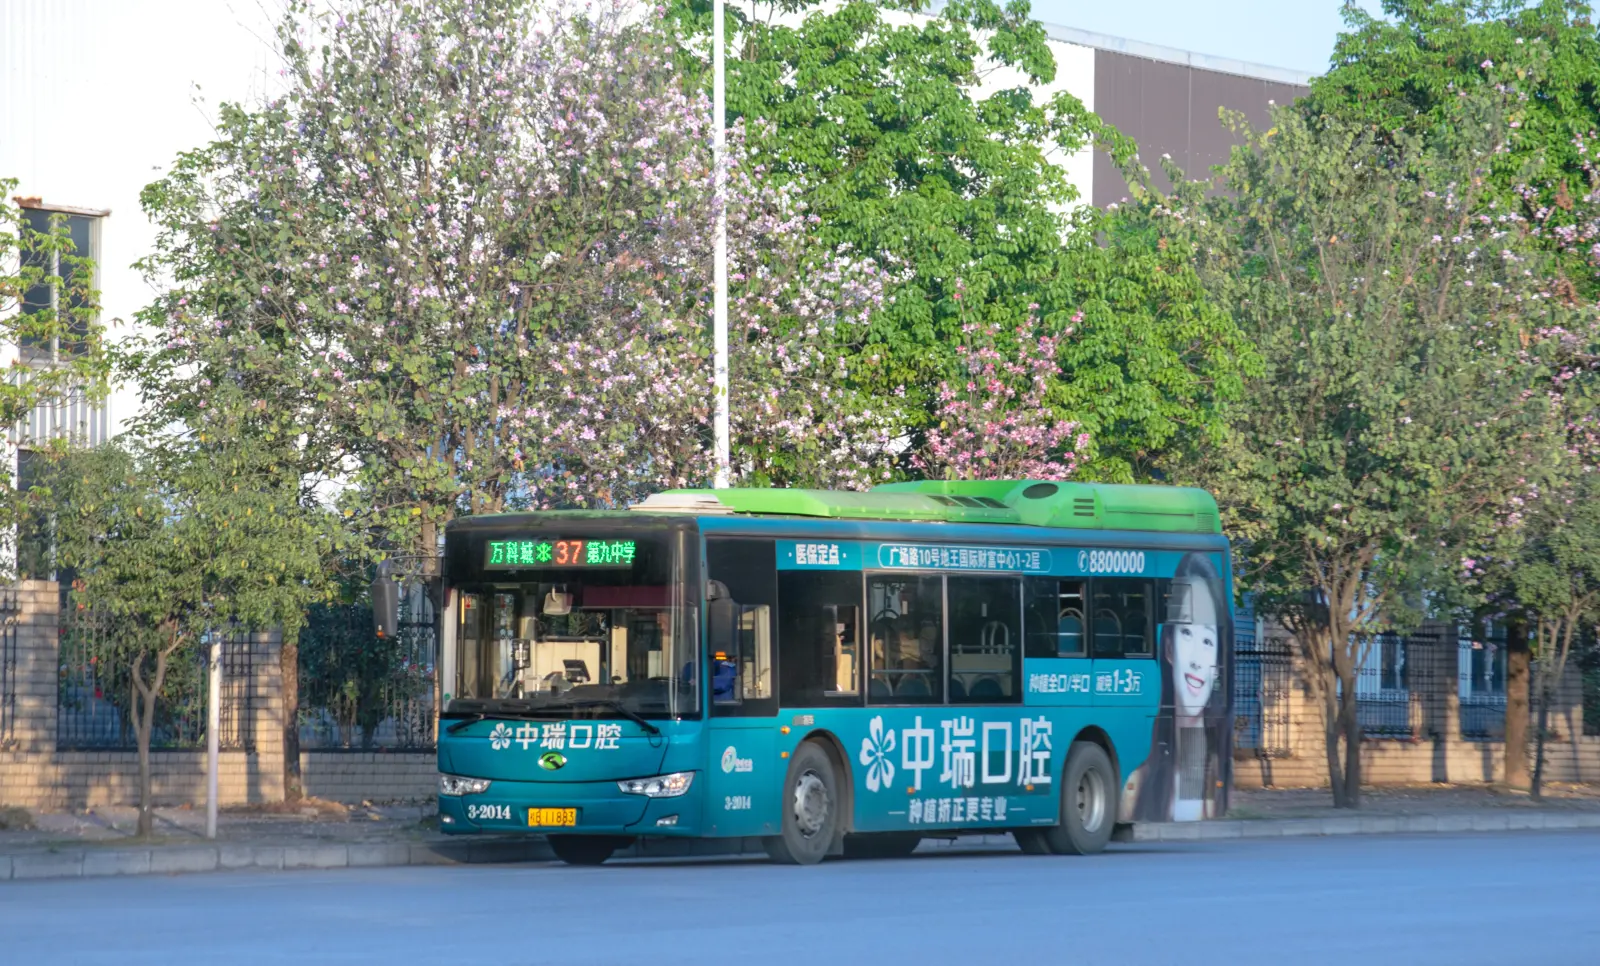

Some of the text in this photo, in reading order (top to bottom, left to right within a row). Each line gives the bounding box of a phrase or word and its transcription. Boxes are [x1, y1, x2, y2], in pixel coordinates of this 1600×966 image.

[556, 540, 582, 564] 37
[586, 541, 636, 564] 第九中学
[795, 544, 840, 565] 医保定点
[889, 546, 1040, 570] 广场路10号地王国际财富中心1-2层
[1089, 550, 1145, 574] 8800000
[515, 722, 622, 750] 中瑞口腔
[901, 715, 1053, 791] 中瑞口腔
[468, 804, 511, 819] 3-2014
[908, 796, 1008, 824] 种植矫正更专业
